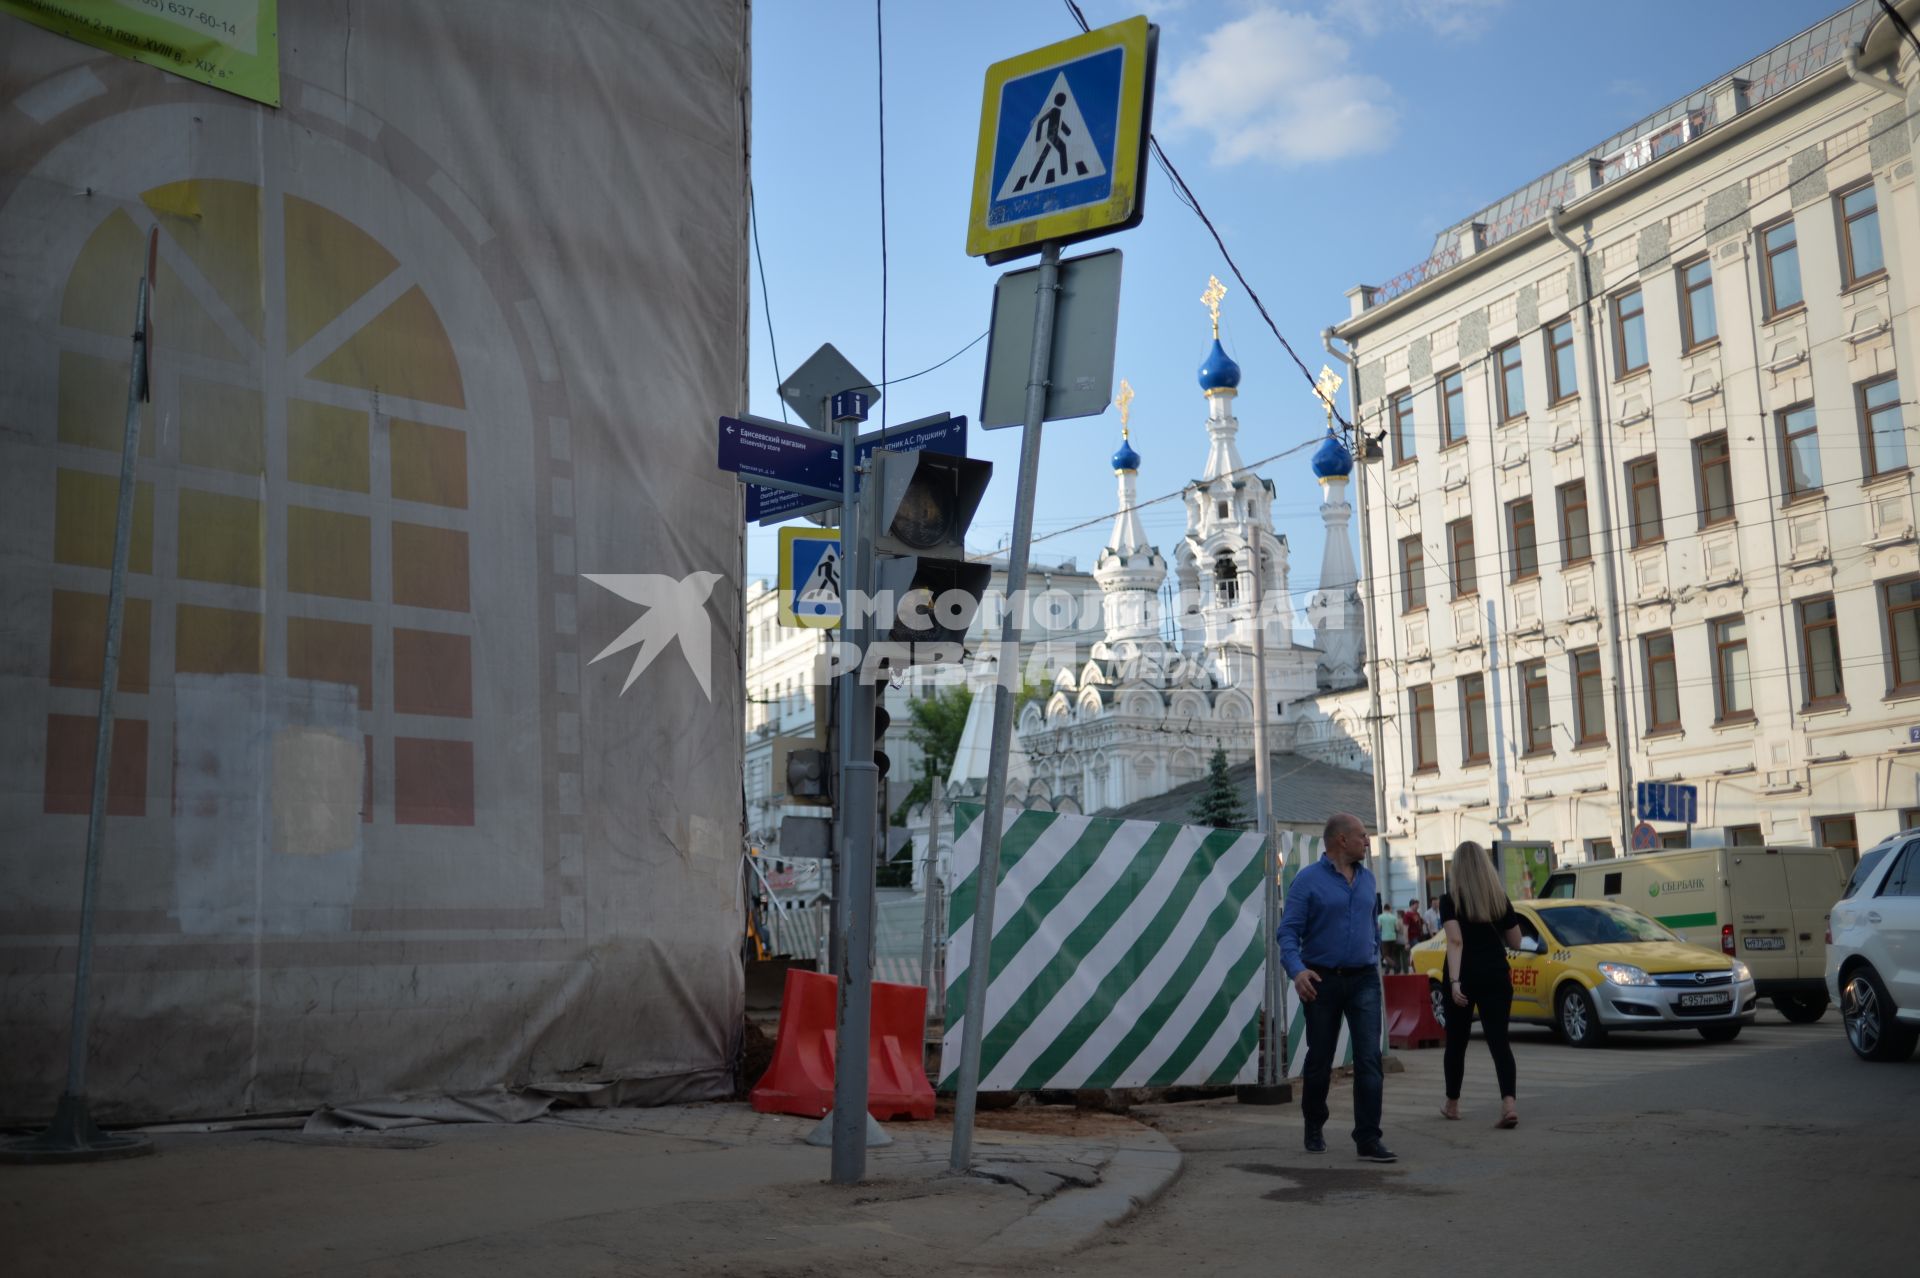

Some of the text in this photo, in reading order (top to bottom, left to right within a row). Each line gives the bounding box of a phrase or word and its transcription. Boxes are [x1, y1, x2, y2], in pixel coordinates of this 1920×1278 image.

[168, 2, 237, 36] 637-60-14
[916, 429, 947, 444] Пушкину
[780, 439, 807, 450] магазин
[1662, 878, 1704, 891] СБЕРБАНК
[1509, 965, 1539, 987] ЕЗЁТ
